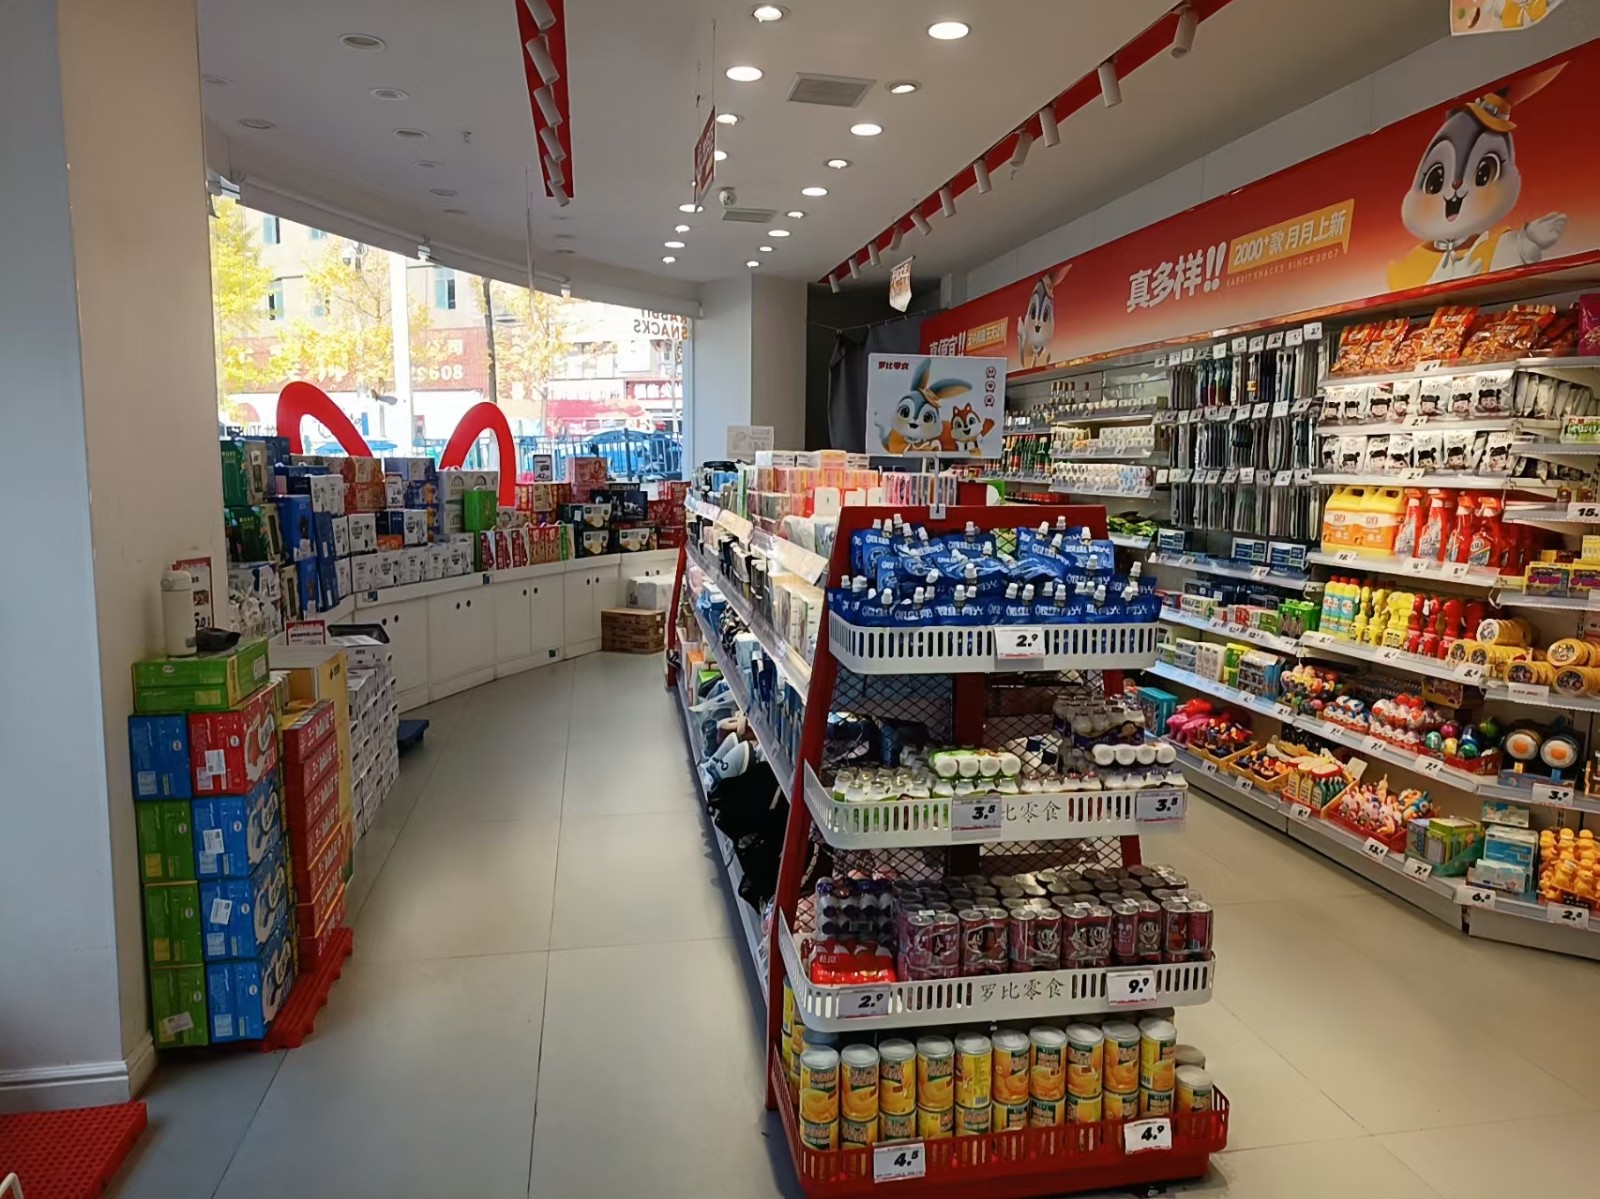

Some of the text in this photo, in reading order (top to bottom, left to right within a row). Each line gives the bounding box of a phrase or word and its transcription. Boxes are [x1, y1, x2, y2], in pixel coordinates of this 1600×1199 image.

[1286, 209, 1347, 250] 月月上新
[1015, 633, 1038, 647] 2.9
[1548, 790, 1569, 801] 3.9
[972, 804, 995, 820] 3.5
[1155, 797, 1178, 812] 3.5
[980, 976, 1065, 1002] 罗比零食
[1128, 977, 1149, 995] 9.9
[858, 993, 883, 1009] 2.9
[1141, 1125, 1164, 1141] 4.9
[894, 1150, 919, 1167] 4.5
